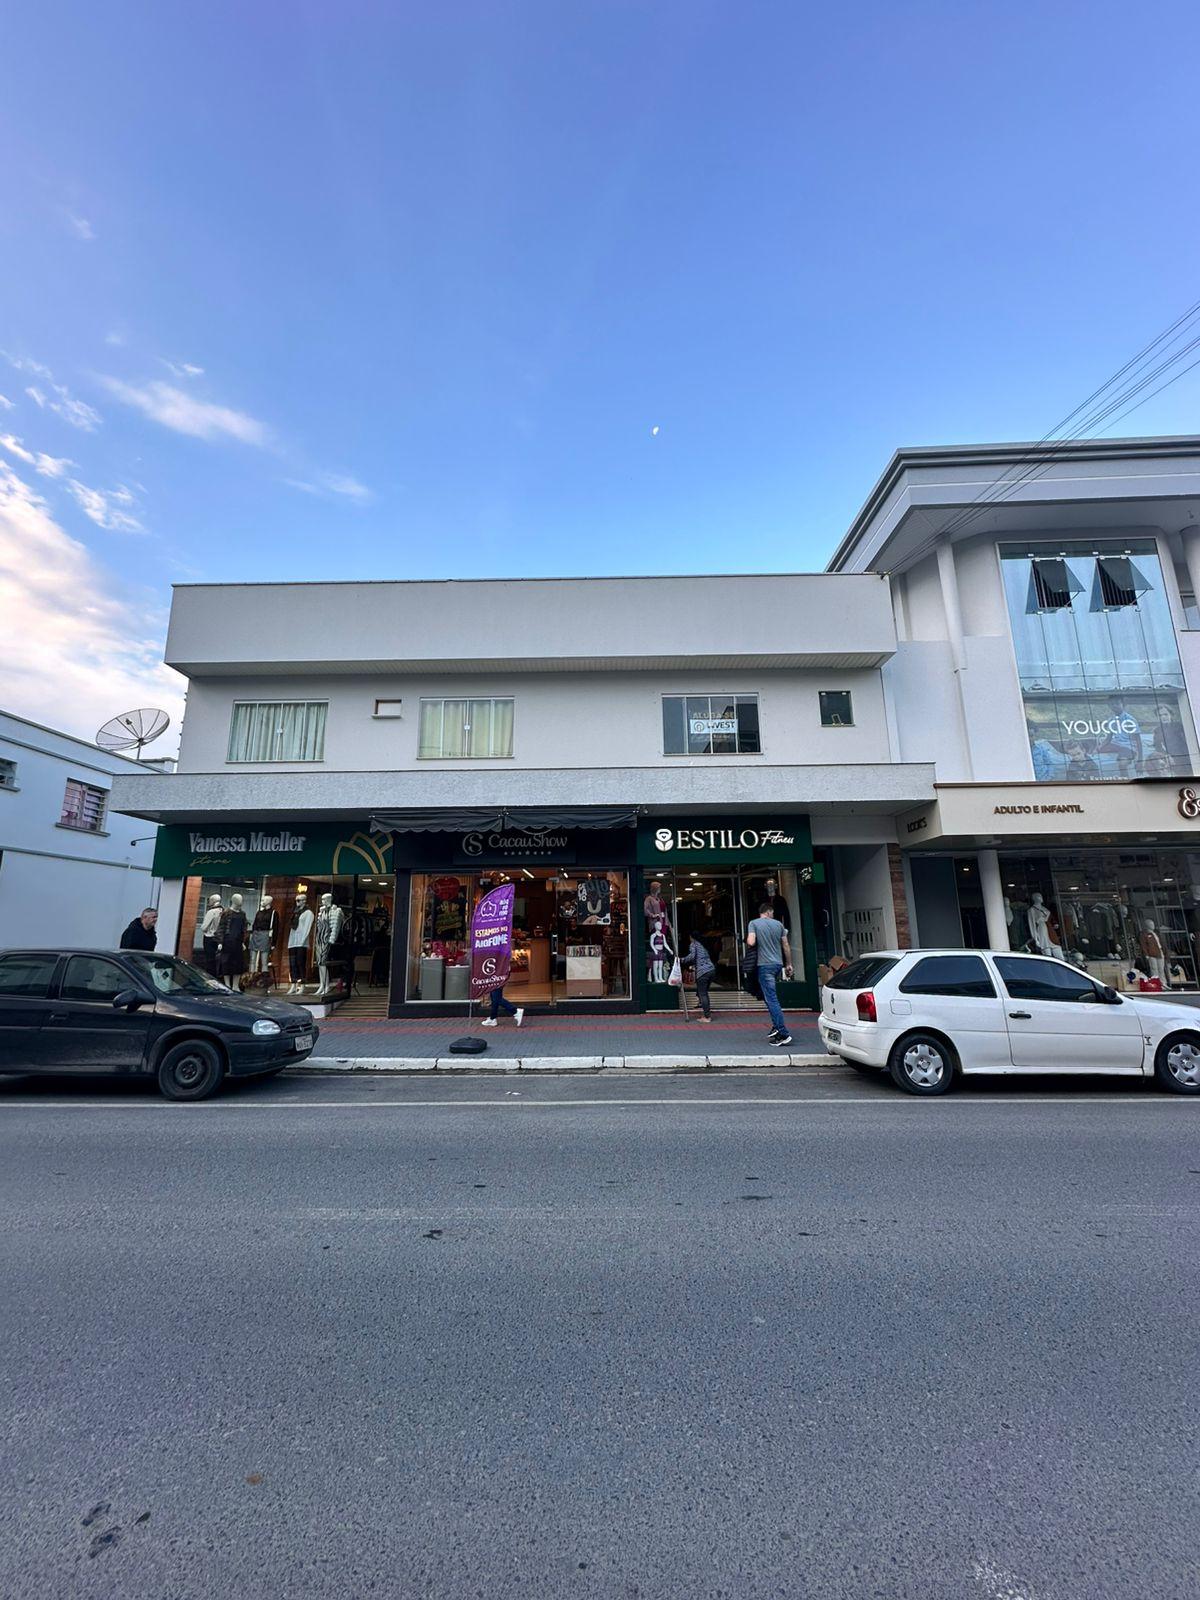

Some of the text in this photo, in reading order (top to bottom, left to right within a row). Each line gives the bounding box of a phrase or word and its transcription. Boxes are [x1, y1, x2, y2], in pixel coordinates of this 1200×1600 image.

[994, 804, 1084, 815] ADULTO E INFANTIL
[189, 831, 307, 853] Vanessa Mueller
[676, 829, 759, 849] ESTILO
